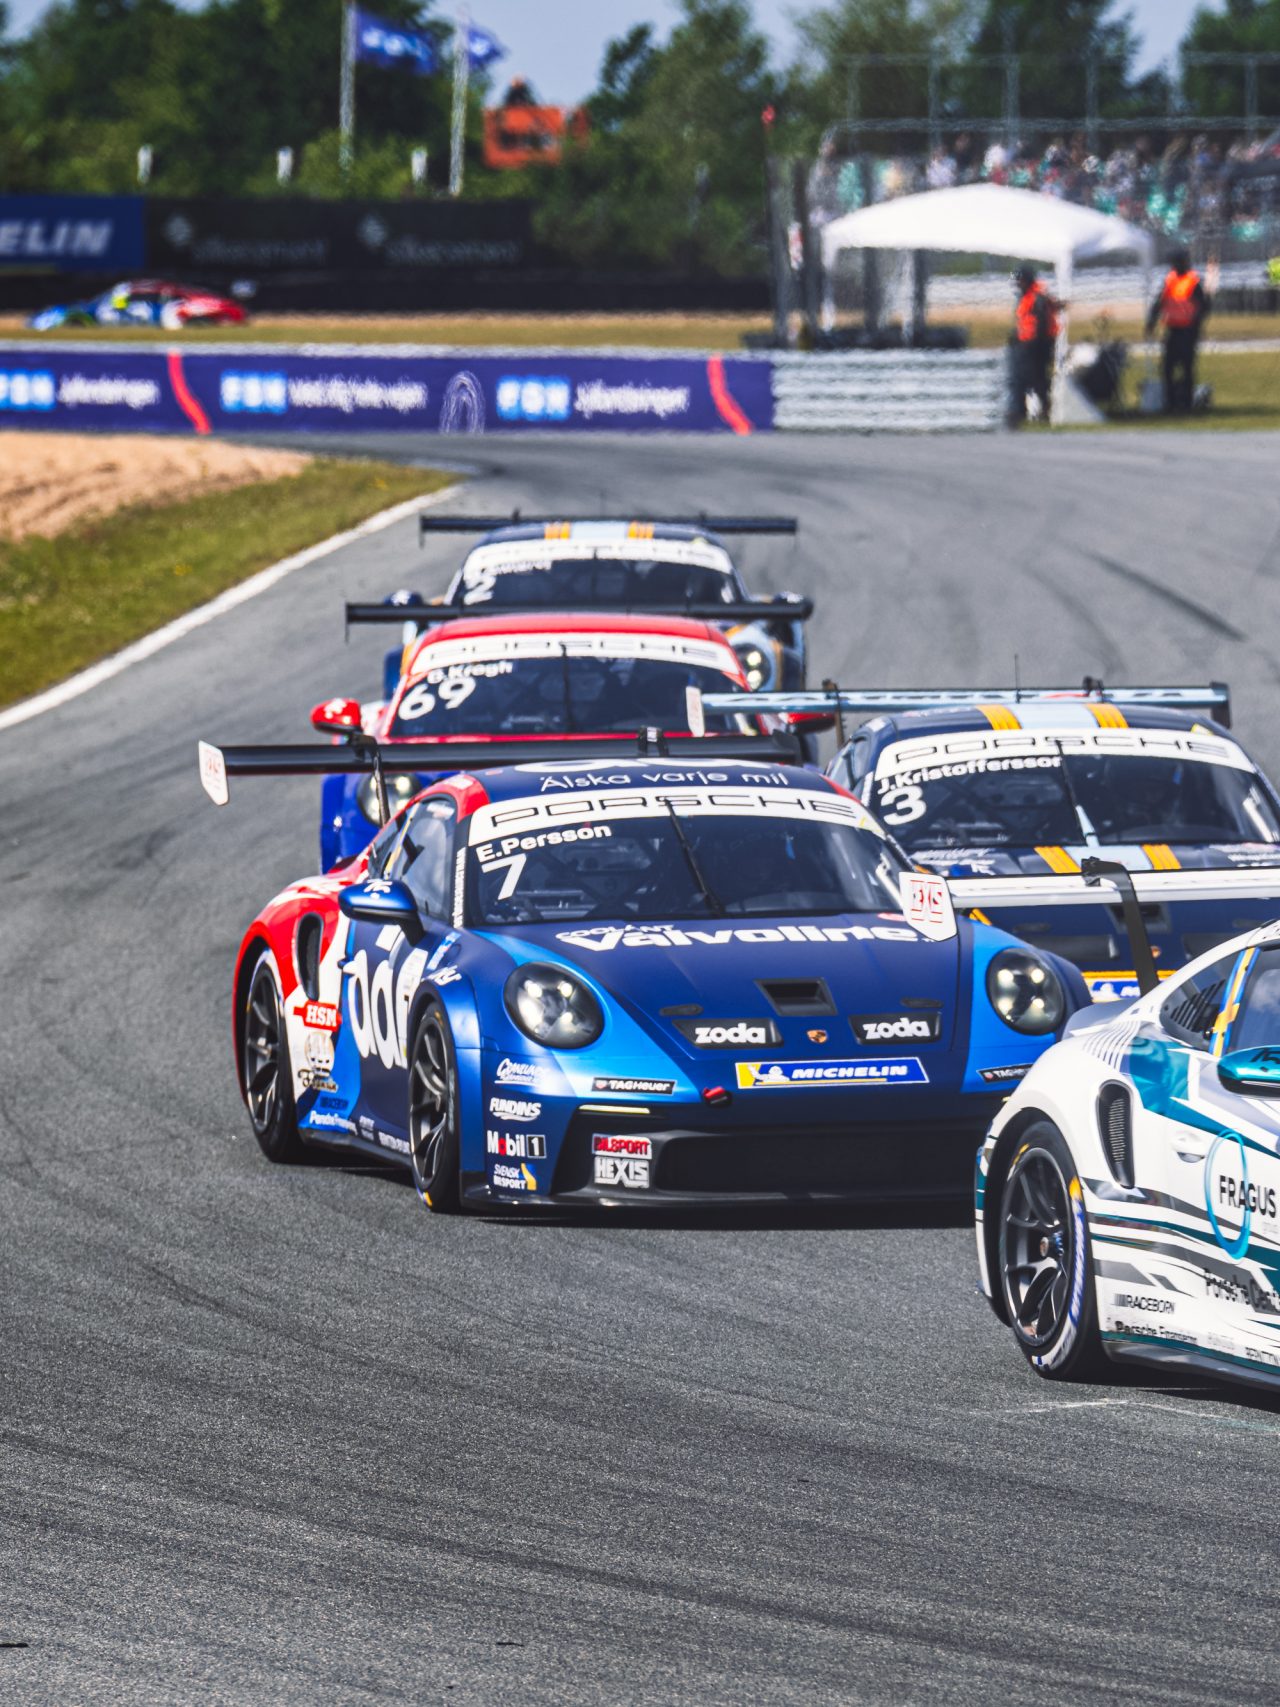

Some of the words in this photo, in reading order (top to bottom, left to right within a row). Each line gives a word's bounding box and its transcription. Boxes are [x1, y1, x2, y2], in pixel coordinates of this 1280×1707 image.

[398, 676, 477, 720] 69
[642, 771, 728, 785] varje
[744, 772, 790, 785] mil
[490, 795, 857, 828] PORSCHE
[880, 785, 928, 826] 3
[475, 825, 613, 863] E.Persson
[481, 853, 528, 900] 7
[560, 925, 919, 951] Valvoline
[305, 1004, 338, 1028] HSM
[862, 1017, 931, 1040] zoda
[695, 1022, 766, 1044] zoda
[791, 1065, 909, 1080] MICHELIN
[486, 1130, 526, 1158] Mobil
[1218, 1174, 1278, 1220] FRAGUS
